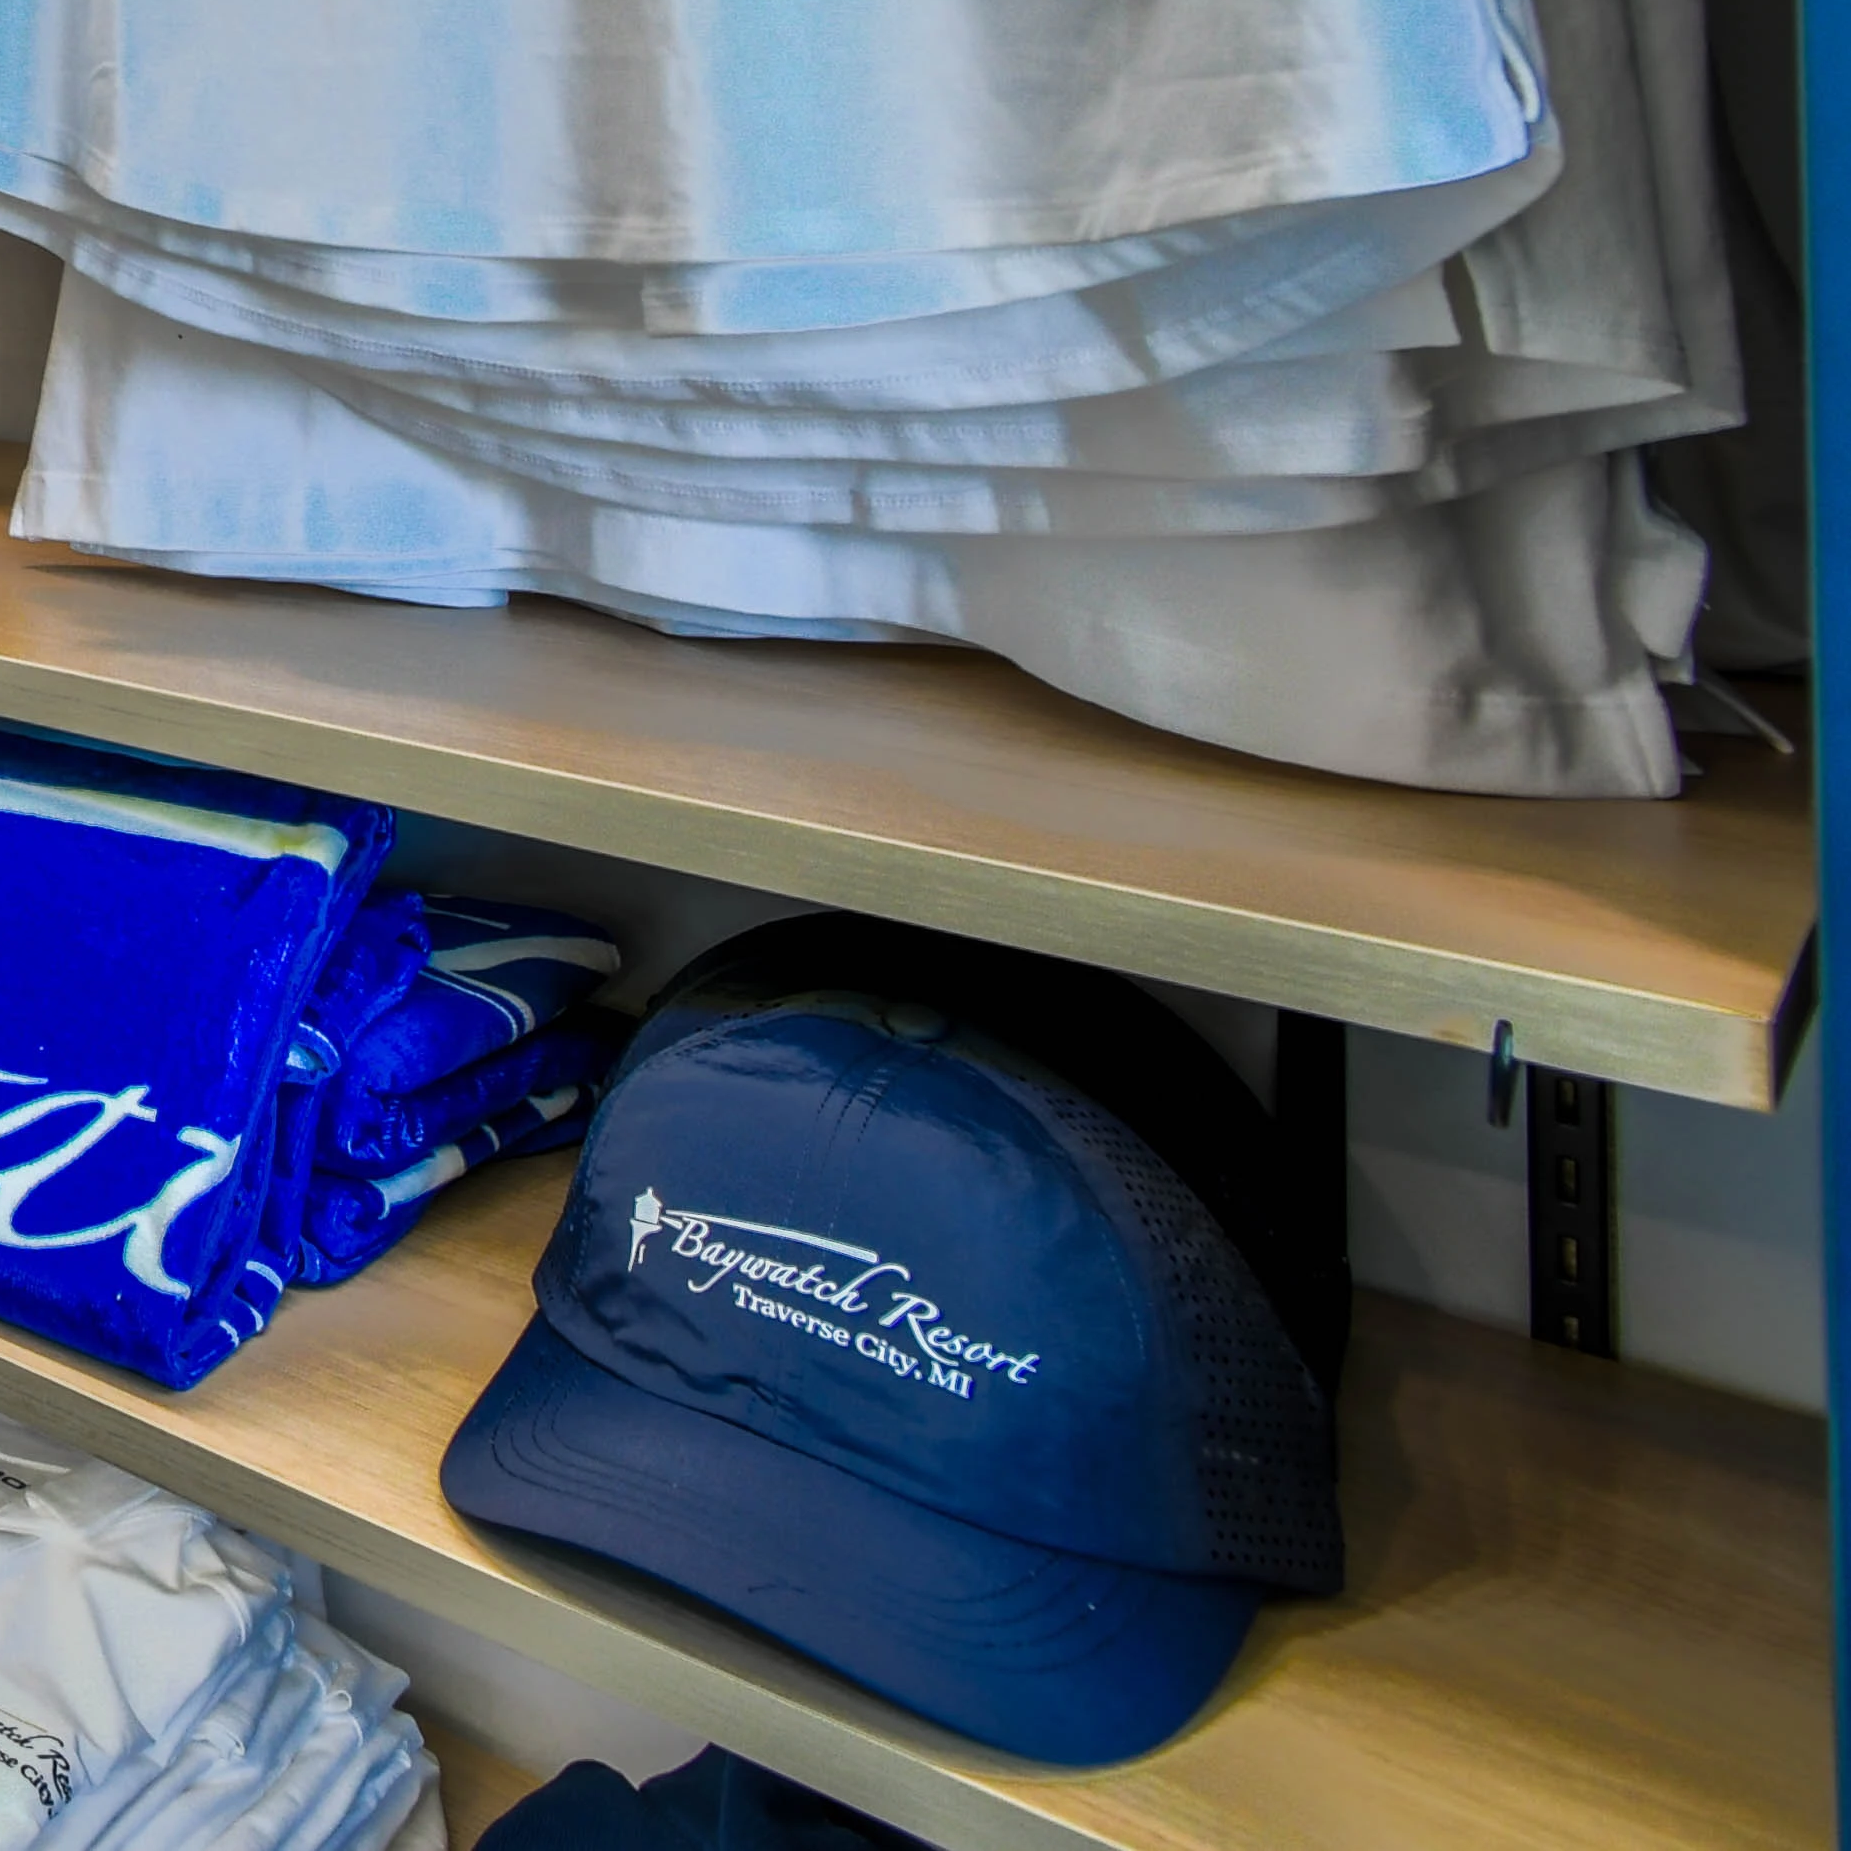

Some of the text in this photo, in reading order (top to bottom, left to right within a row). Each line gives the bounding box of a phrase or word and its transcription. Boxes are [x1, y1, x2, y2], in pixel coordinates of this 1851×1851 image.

[671, 1216, 1041, 1386] Baywatch Resort
[732, 1282, 850, 1347] Traverse
[927, 1361, 974, 1400] MI
